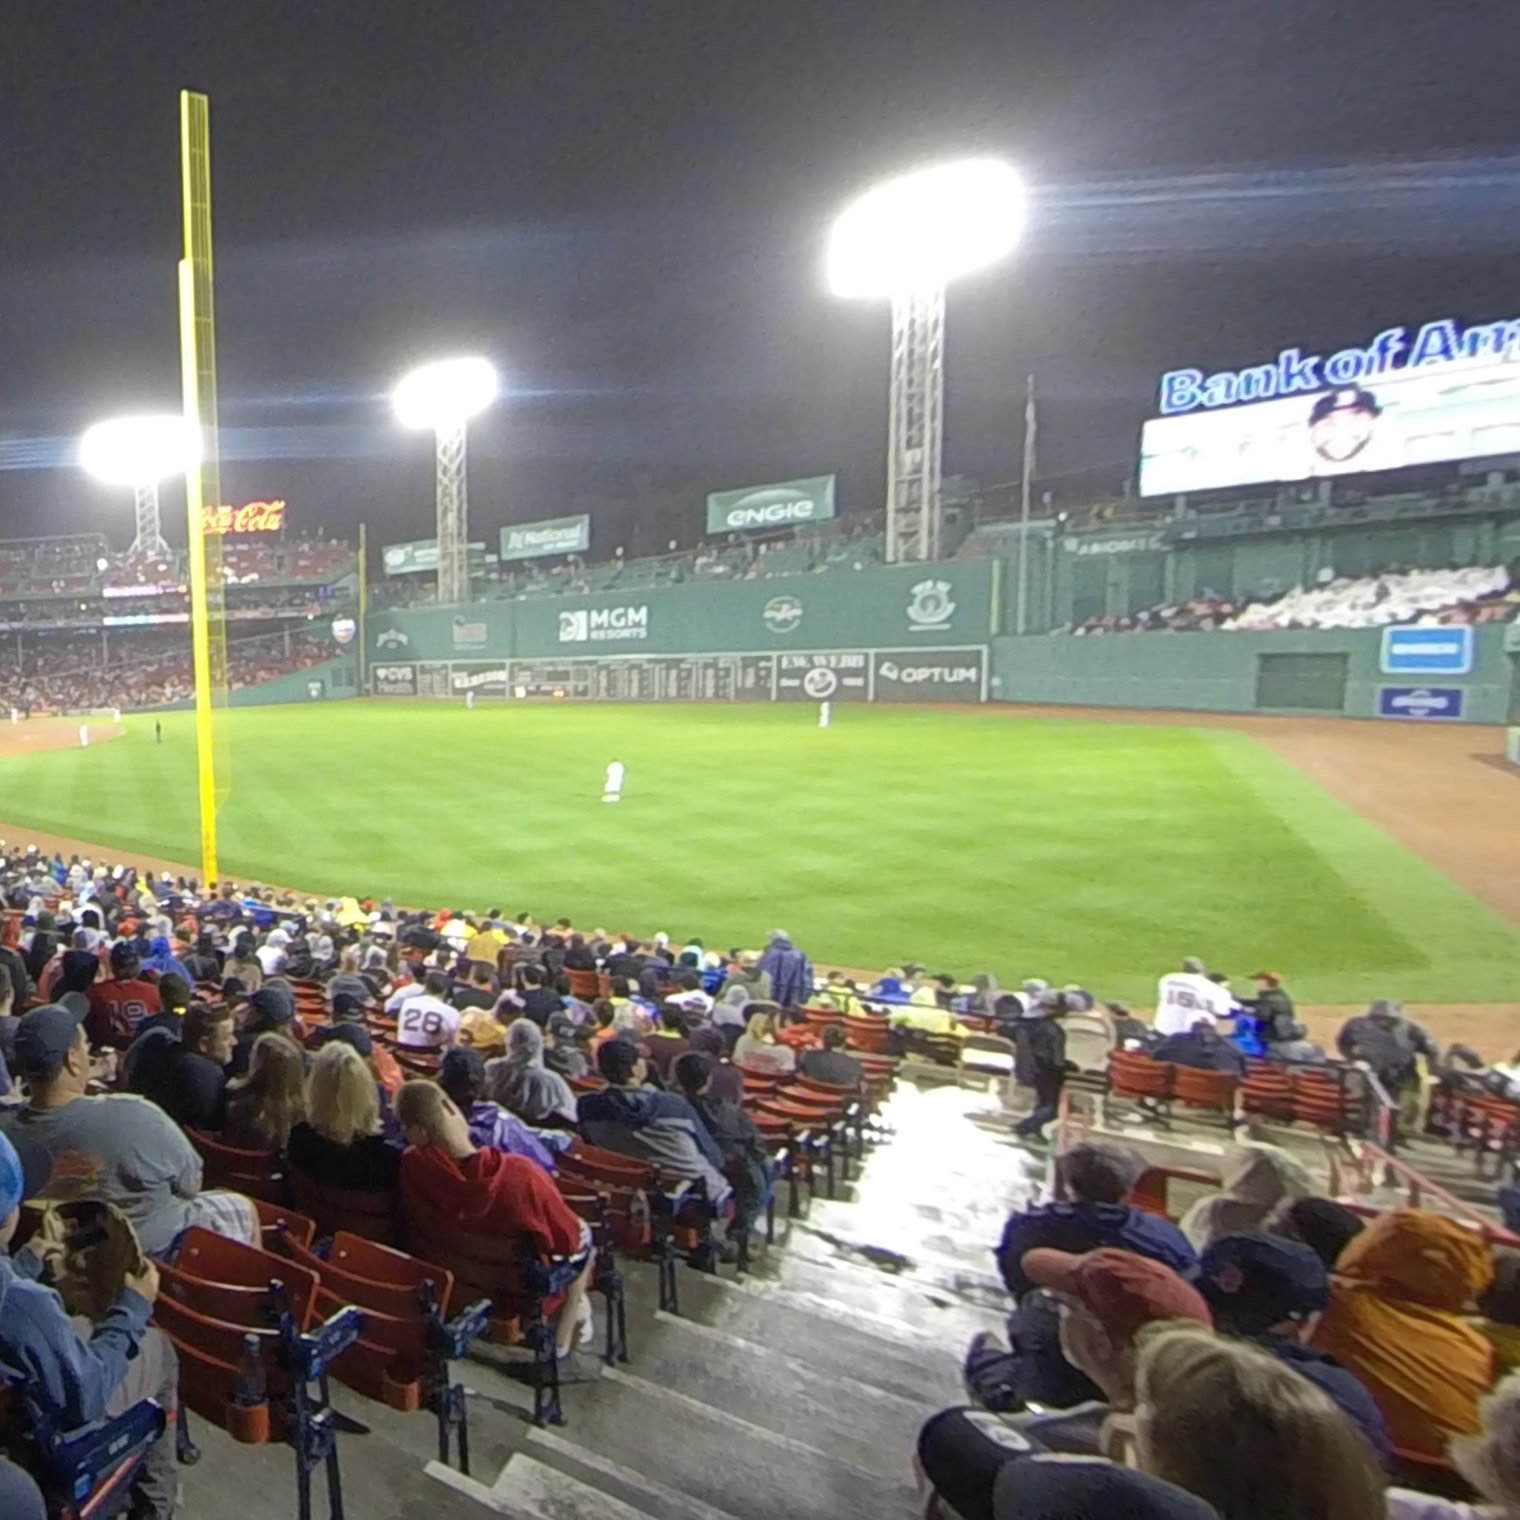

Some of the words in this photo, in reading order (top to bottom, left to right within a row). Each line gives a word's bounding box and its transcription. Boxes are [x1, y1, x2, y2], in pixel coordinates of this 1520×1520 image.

[1159, 347, 1321, 415] Bank
[1324, 327, 1406, 385] of
[589, 605, 648, 628] MGM
[589, 627, 648, 640] RESORTS
[900, 667, 977, 683] OPTUM
[402, 1008, 443, 1034] 28
